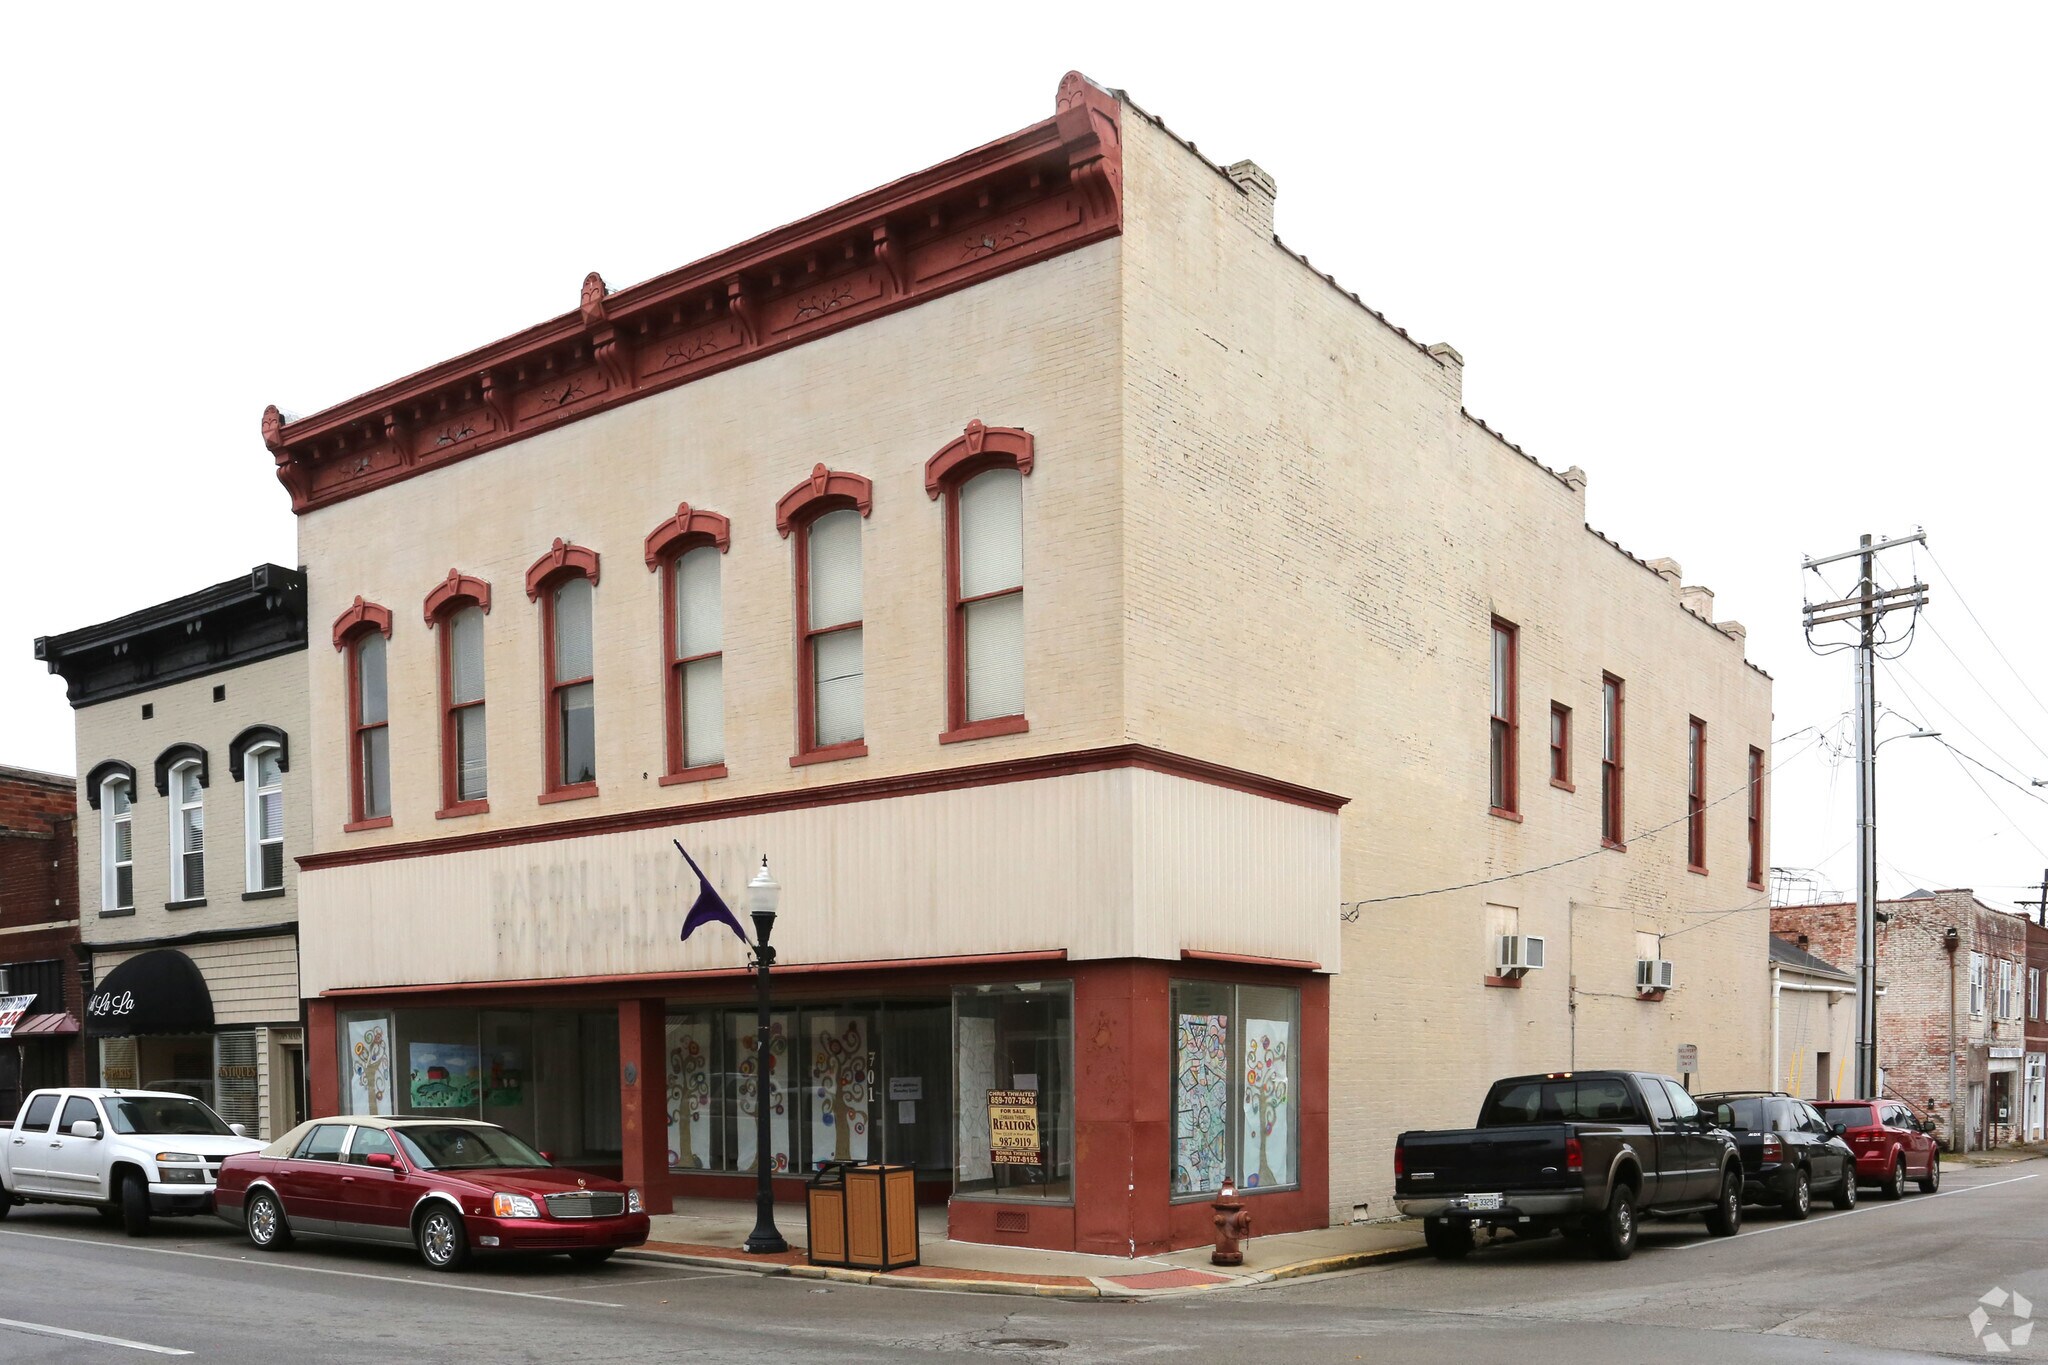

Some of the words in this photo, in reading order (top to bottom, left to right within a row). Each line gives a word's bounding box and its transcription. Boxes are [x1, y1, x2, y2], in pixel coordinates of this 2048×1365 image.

[111, 990, 135, 1015] La
[219, 1066, 256, 1079] ANTIQUES
[867, 1052, 875, 1102] 701
[990, 1096, 1034, 1104] 859-707-7843
[993, 1118, 1036, 1130] REALTORS
[999, 1137, 1032, 1147] 987-9119
[995, 1155, 1038, 1163] 859-707-8152
[1479, 1198, 1494, 1206] 3329
